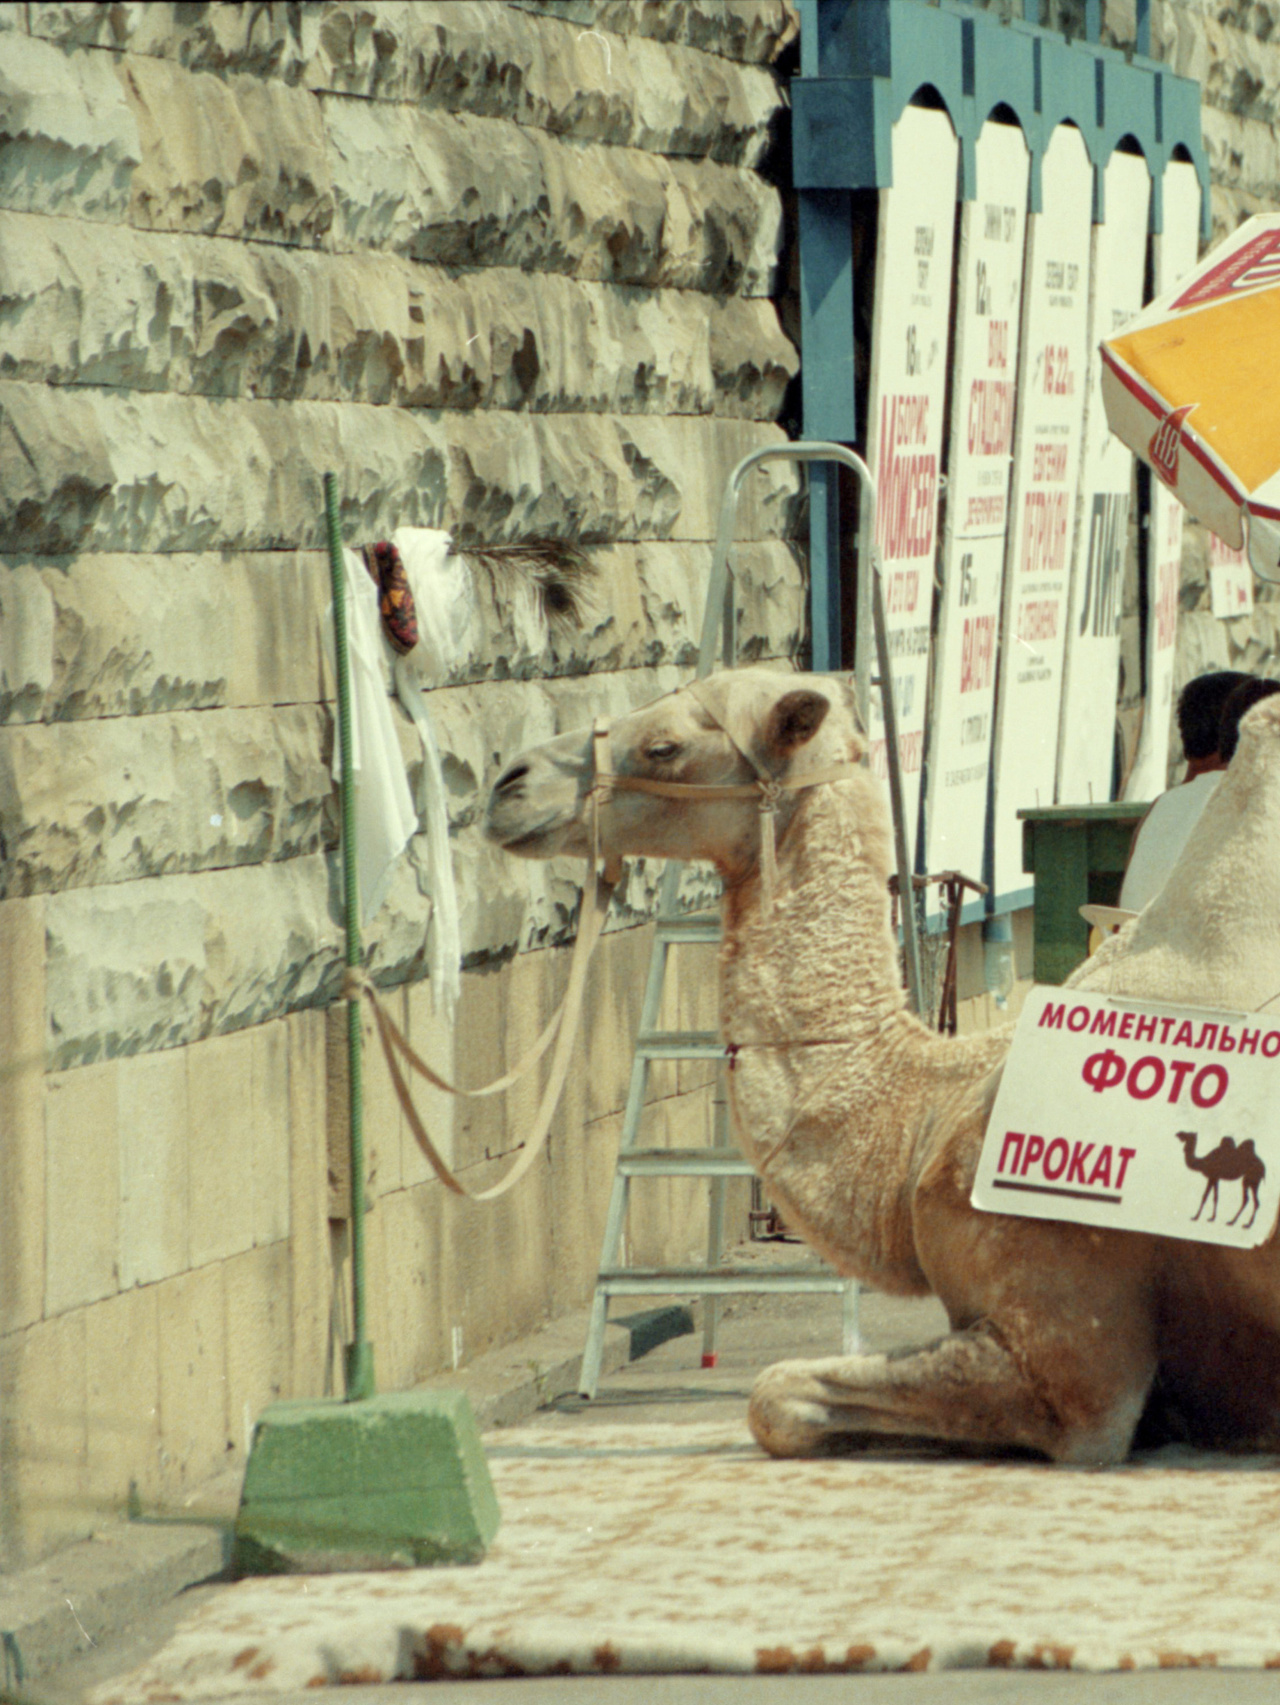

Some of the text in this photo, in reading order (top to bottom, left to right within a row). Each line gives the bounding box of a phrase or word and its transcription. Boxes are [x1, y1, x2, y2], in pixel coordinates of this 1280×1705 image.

[1153, 415, 1181, 469] HB
[1081, 1048, 1230, 1109] ФОТО
[996, 1131, 1137, 1190] ПРОКАТ
